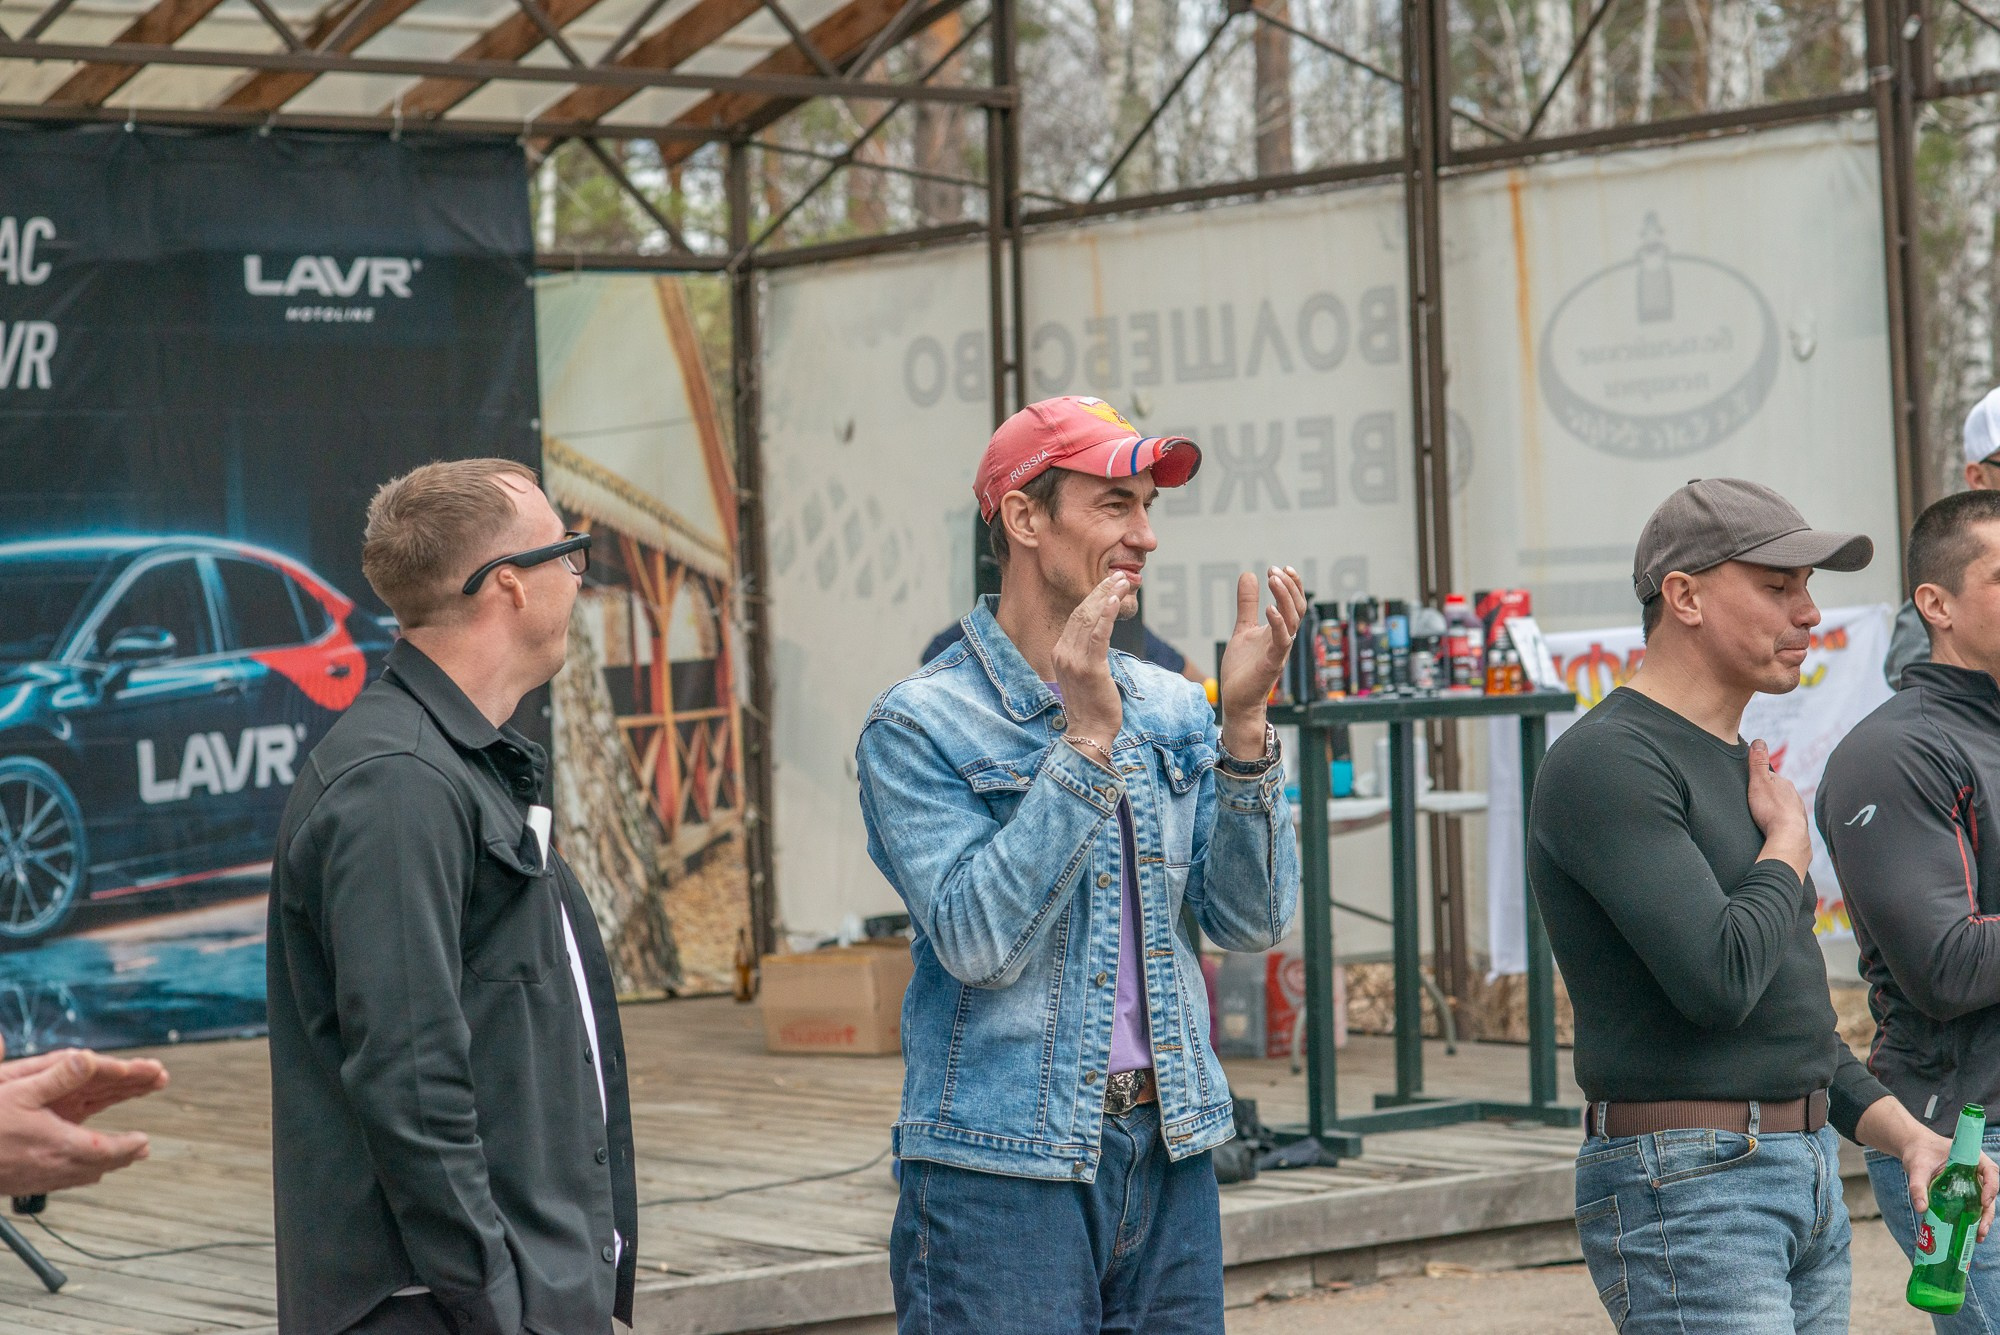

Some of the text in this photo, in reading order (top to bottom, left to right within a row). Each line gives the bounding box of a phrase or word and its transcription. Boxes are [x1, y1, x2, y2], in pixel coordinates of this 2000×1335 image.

[243, 254, 413, 299] LAVR
[285, 307, 376, 323] MOTOLINE
[1009, 449, 1050, 483] RUSSIA
[136, 724, 299, 804] LAVR
